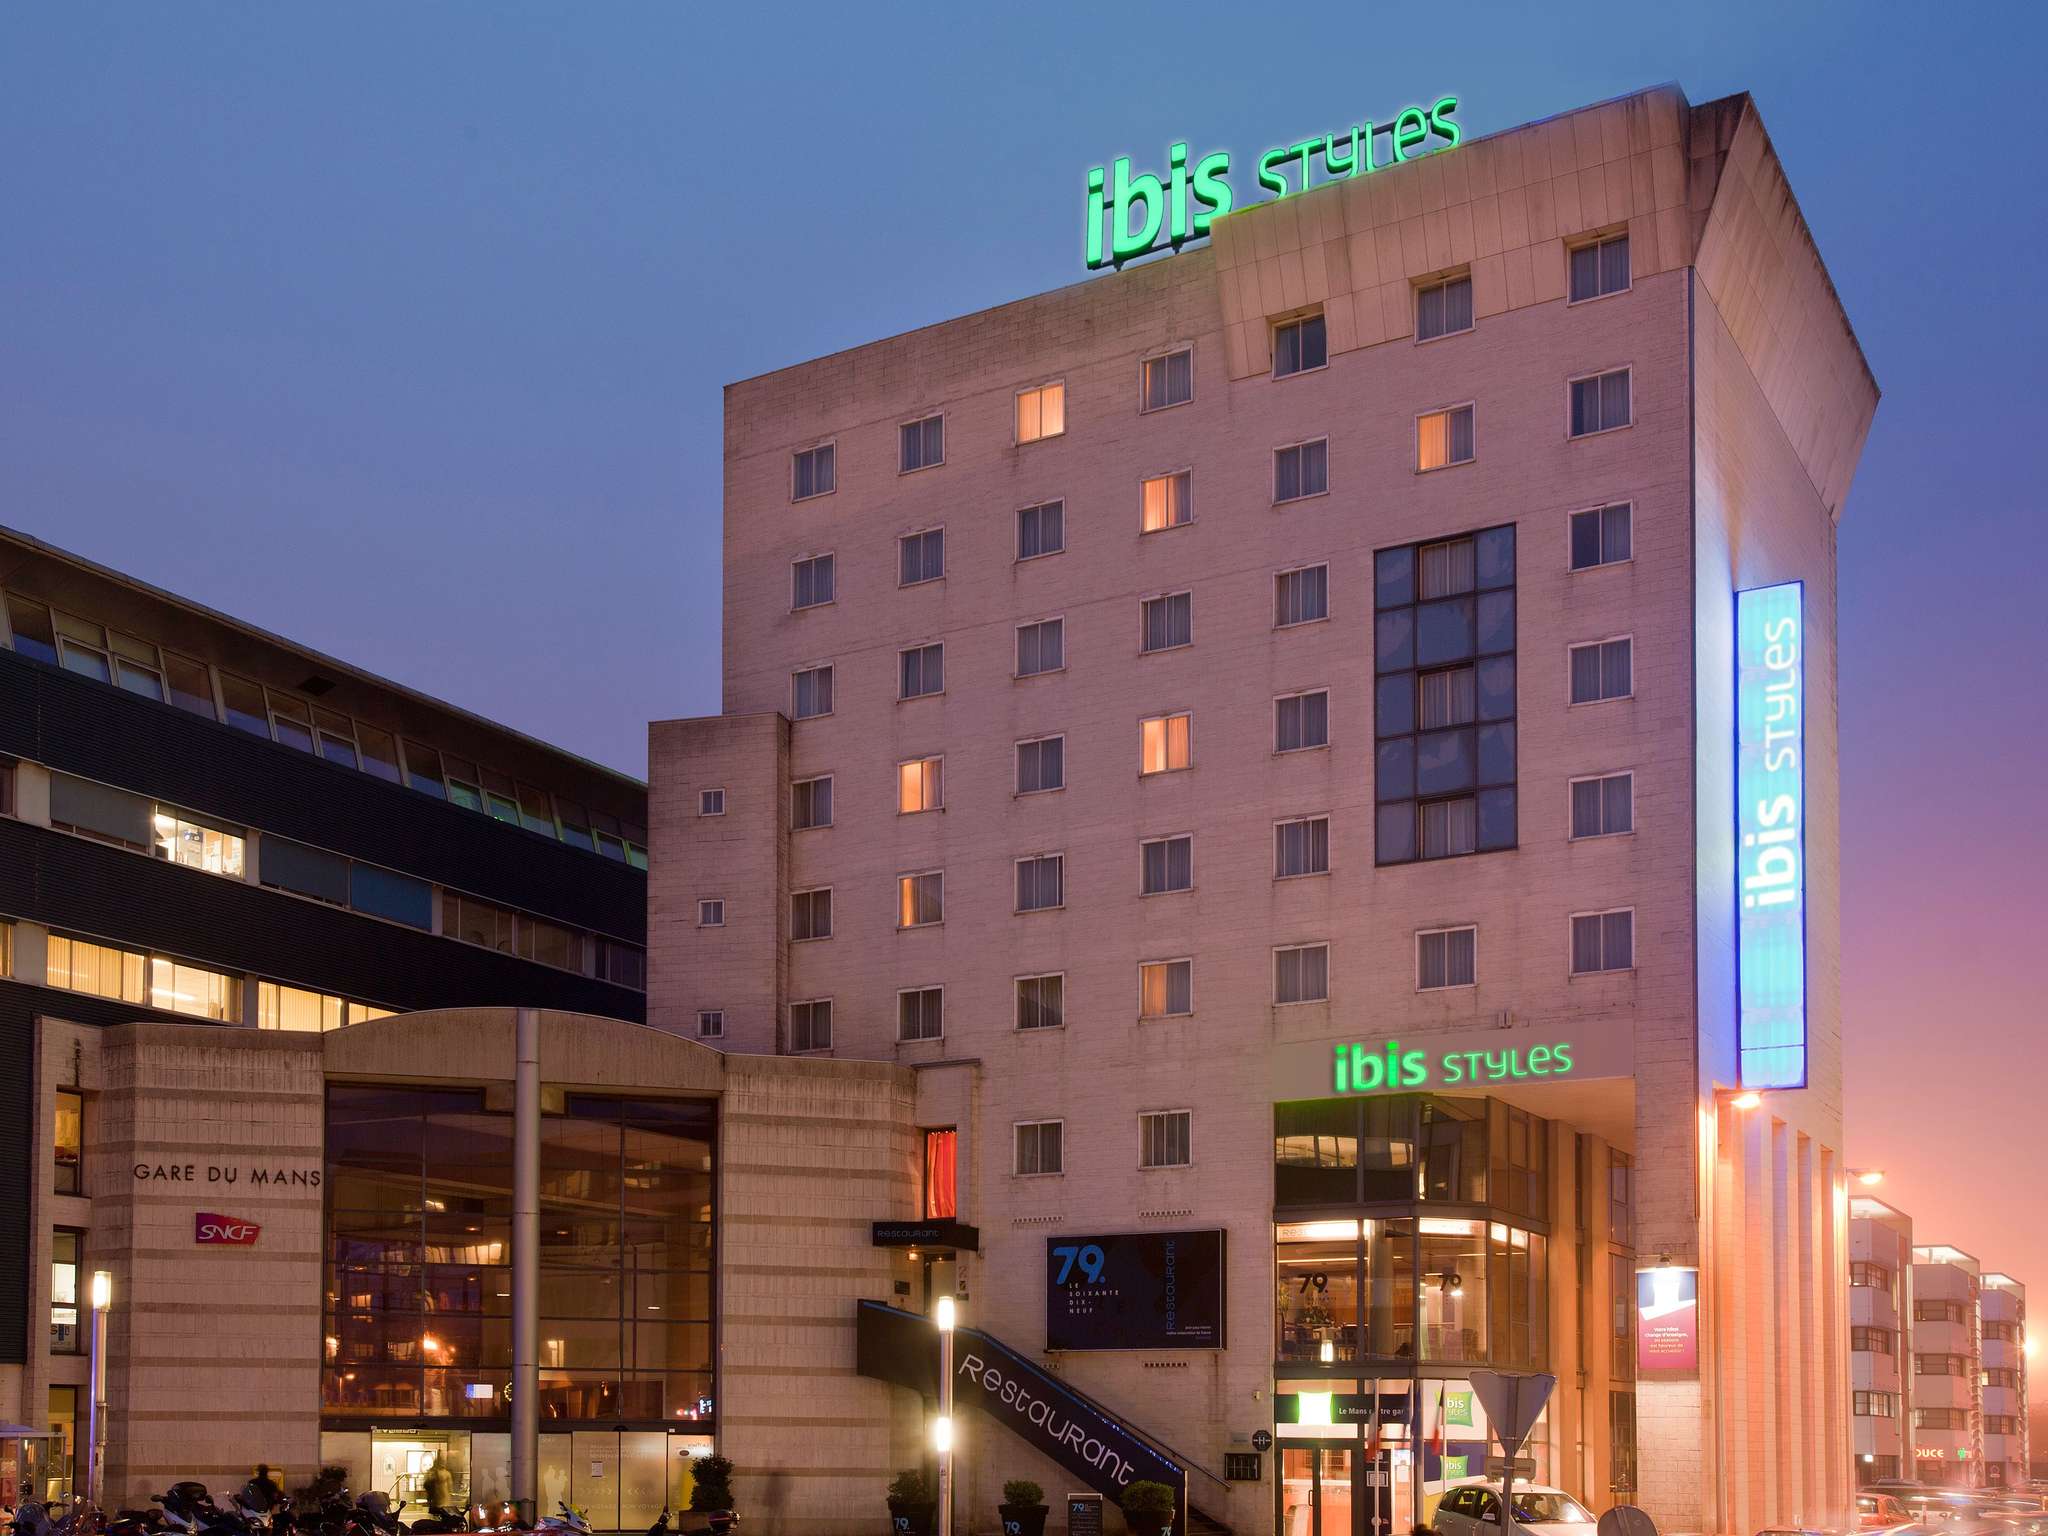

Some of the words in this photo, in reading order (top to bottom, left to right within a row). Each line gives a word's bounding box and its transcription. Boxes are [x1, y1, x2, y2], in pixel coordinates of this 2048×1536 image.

[1086, 142, 1233, 270] ibis
[1744, 793, 1796, 909] ibis
[1335, 1041, 1428, 1093] ibis
[134, 1164, 195, 1181] GARE
[208, 1166, 238, 1184] DU
[251, 1168, 321, 1186] MANS
[198, 1224, 257, 1240] SNCF
[1338, 1407, 1347, 1415] Le
[1348, 1407, 1367, 1415] Mans
[1446, 1397, 1465, 1408] bis
